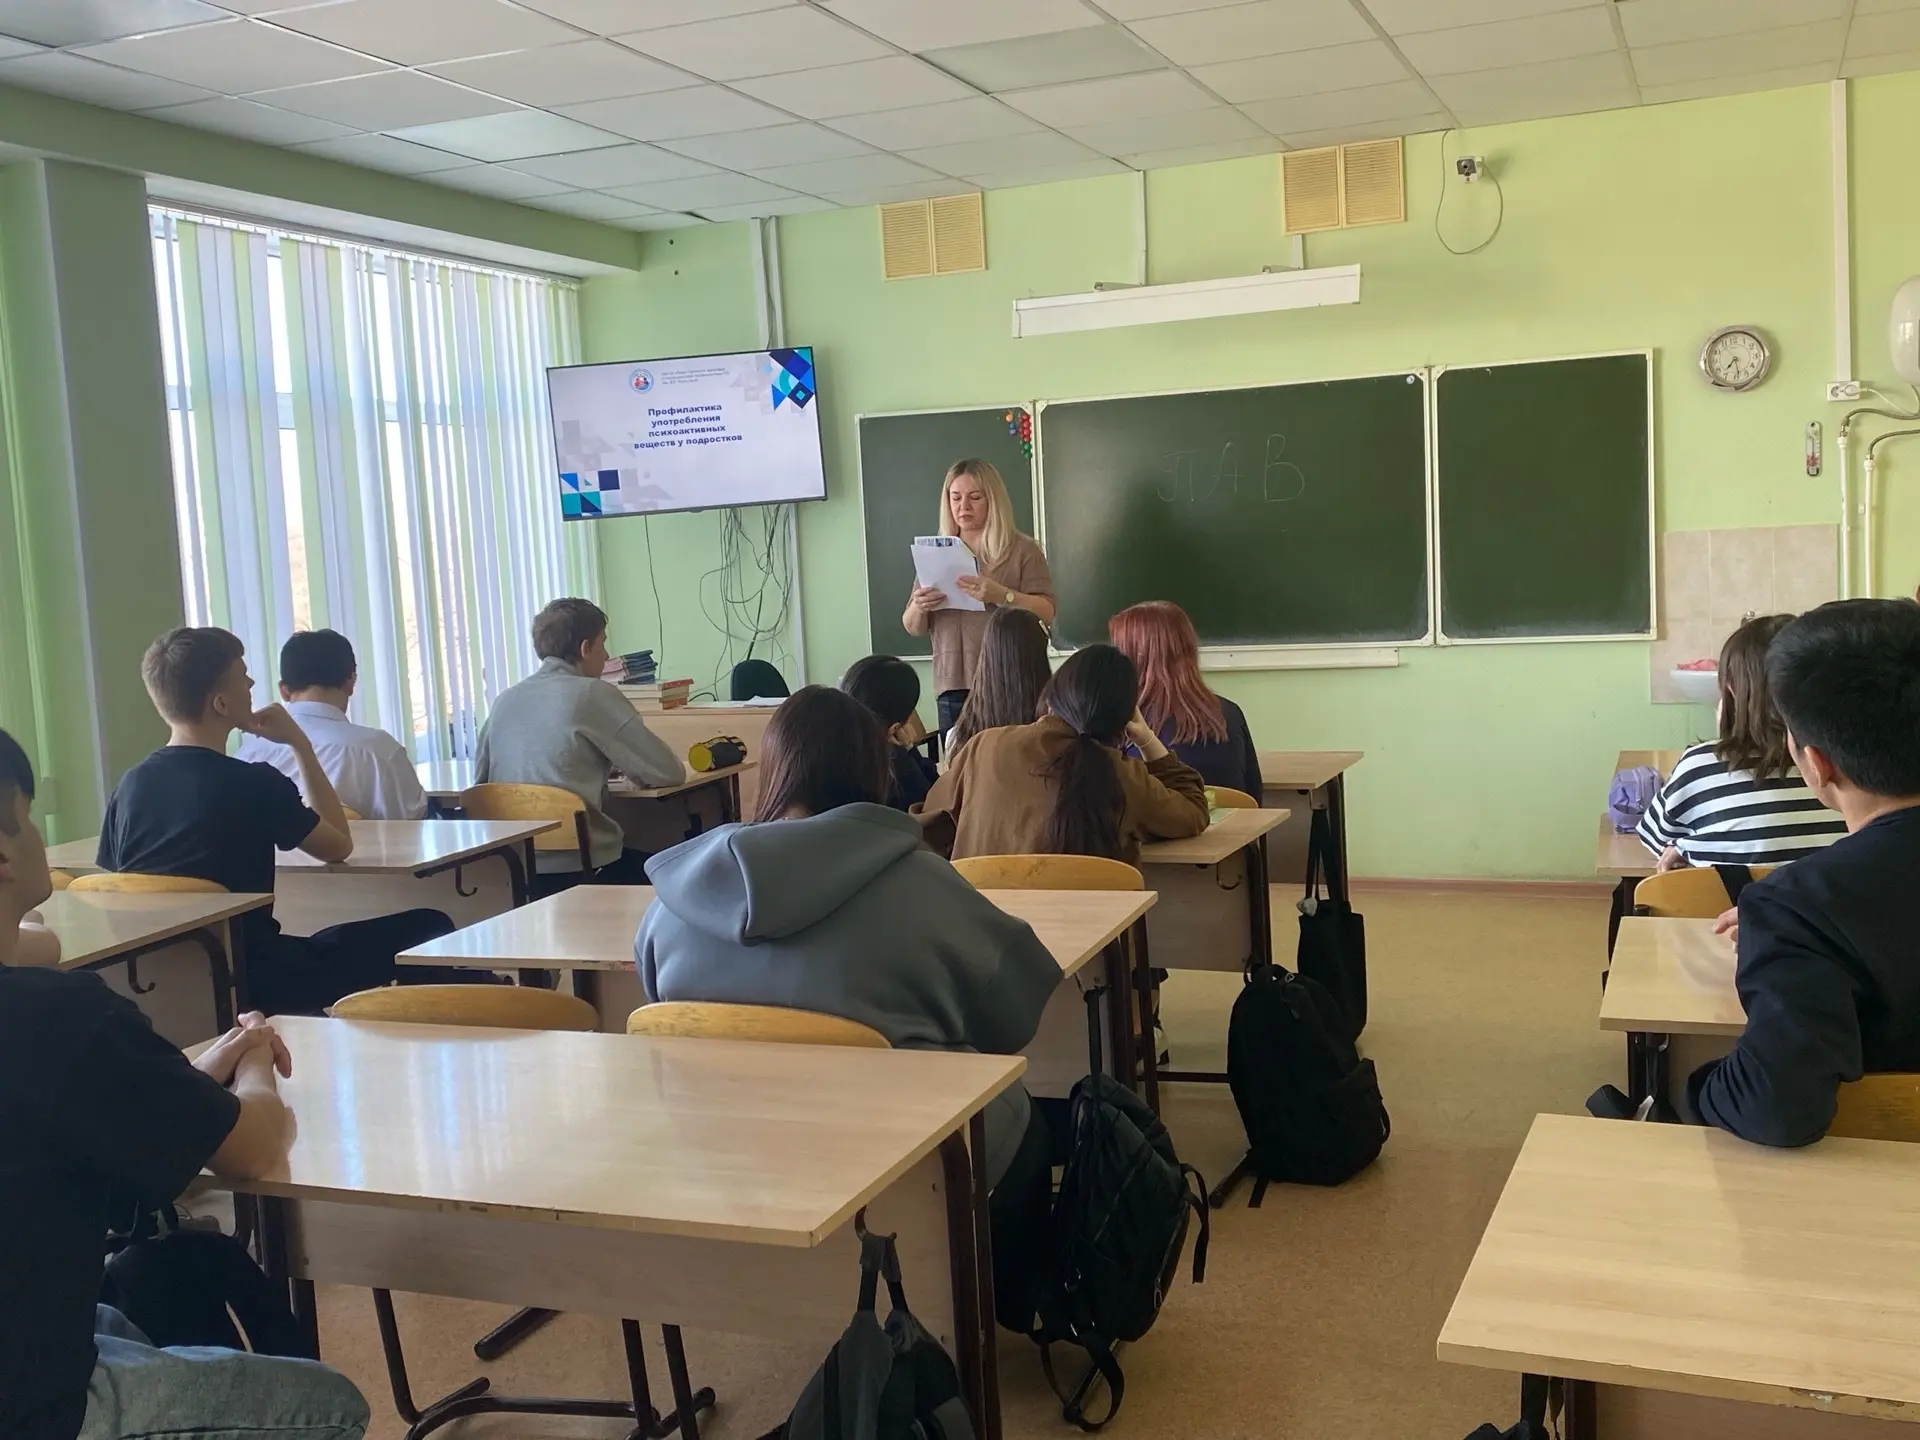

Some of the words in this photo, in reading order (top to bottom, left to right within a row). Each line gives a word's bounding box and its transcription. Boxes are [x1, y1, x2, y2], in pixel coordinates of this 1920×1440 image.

[648, 404, 722, 417] Профилактика
[651, 415, 721, 428] употребления
[648, 425, 726, 437] психоактивных
[634, 440, 676, 449] веществ
[677, 439, 684, 447] у
[686, 434, 743, 446] подростков
